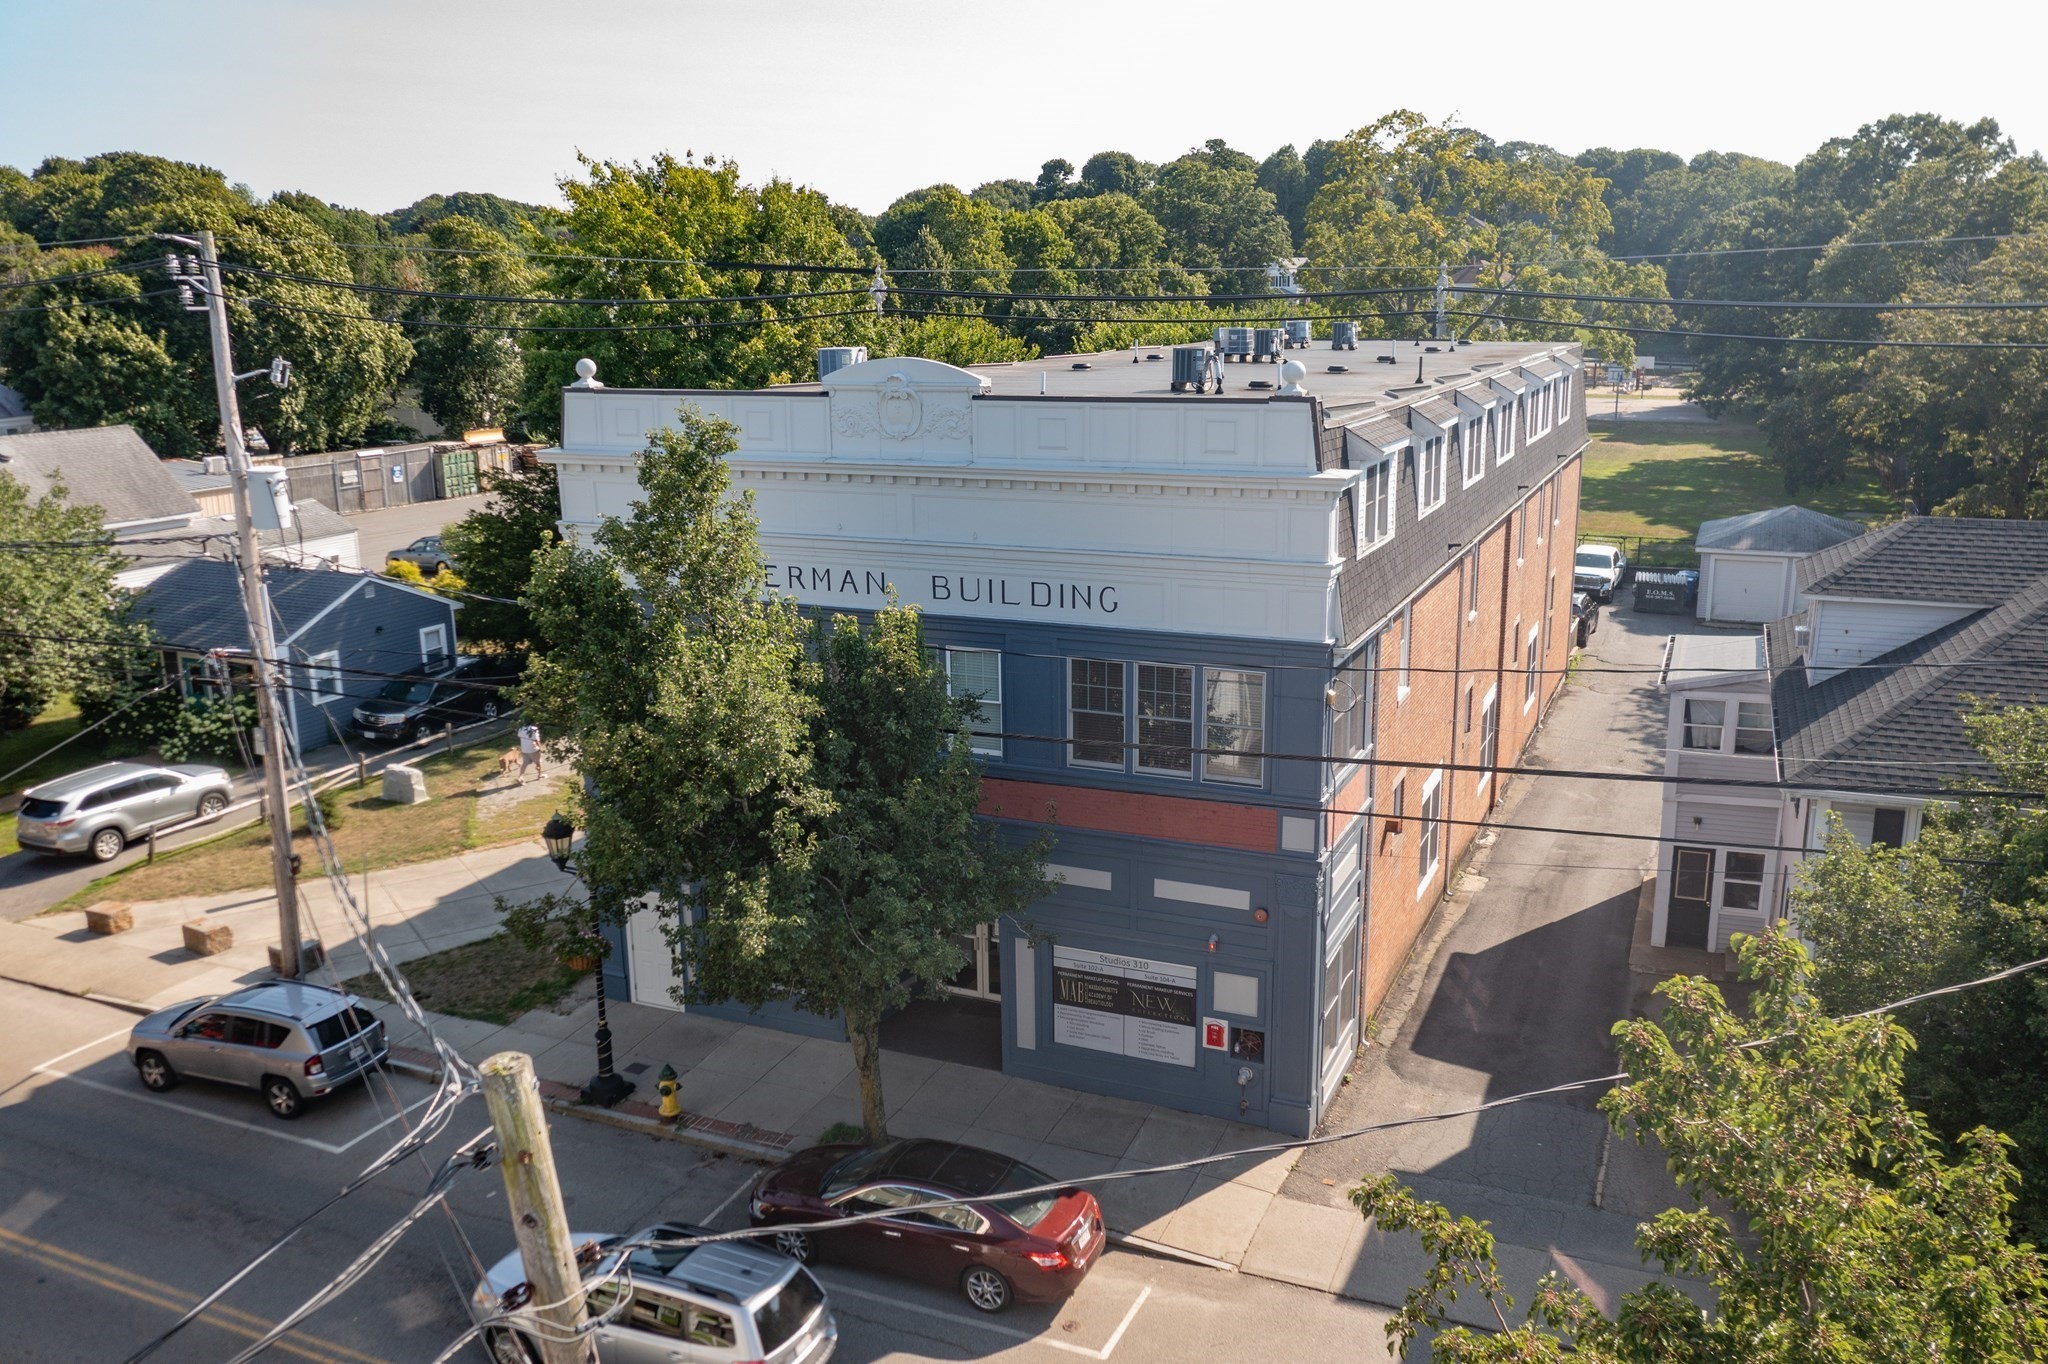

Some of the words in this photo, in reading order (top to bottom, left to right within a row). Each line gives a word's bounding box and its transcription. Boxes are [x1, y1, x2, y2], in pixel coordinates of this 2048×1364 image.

[931, 574, 1119, 613] BUILDING
[1073, 962, 1087, 970] Suite
[1088, 964, 1104, 972] 102-A
[1099, 955, 1131, 967] Studios
[1133, 960, 1149, 970] 310
[1057, 971, 1083, 979] PERMANENT
[1060, 978, 1084, 1003] MAB
[1127, 982, 1154, 990] PERMANENT
[1154, 986, 1173, 994] MAKEUP
[1173, 989, 1194, 997] SERVICES
[1129, 989, 1177, 1012] NEW
